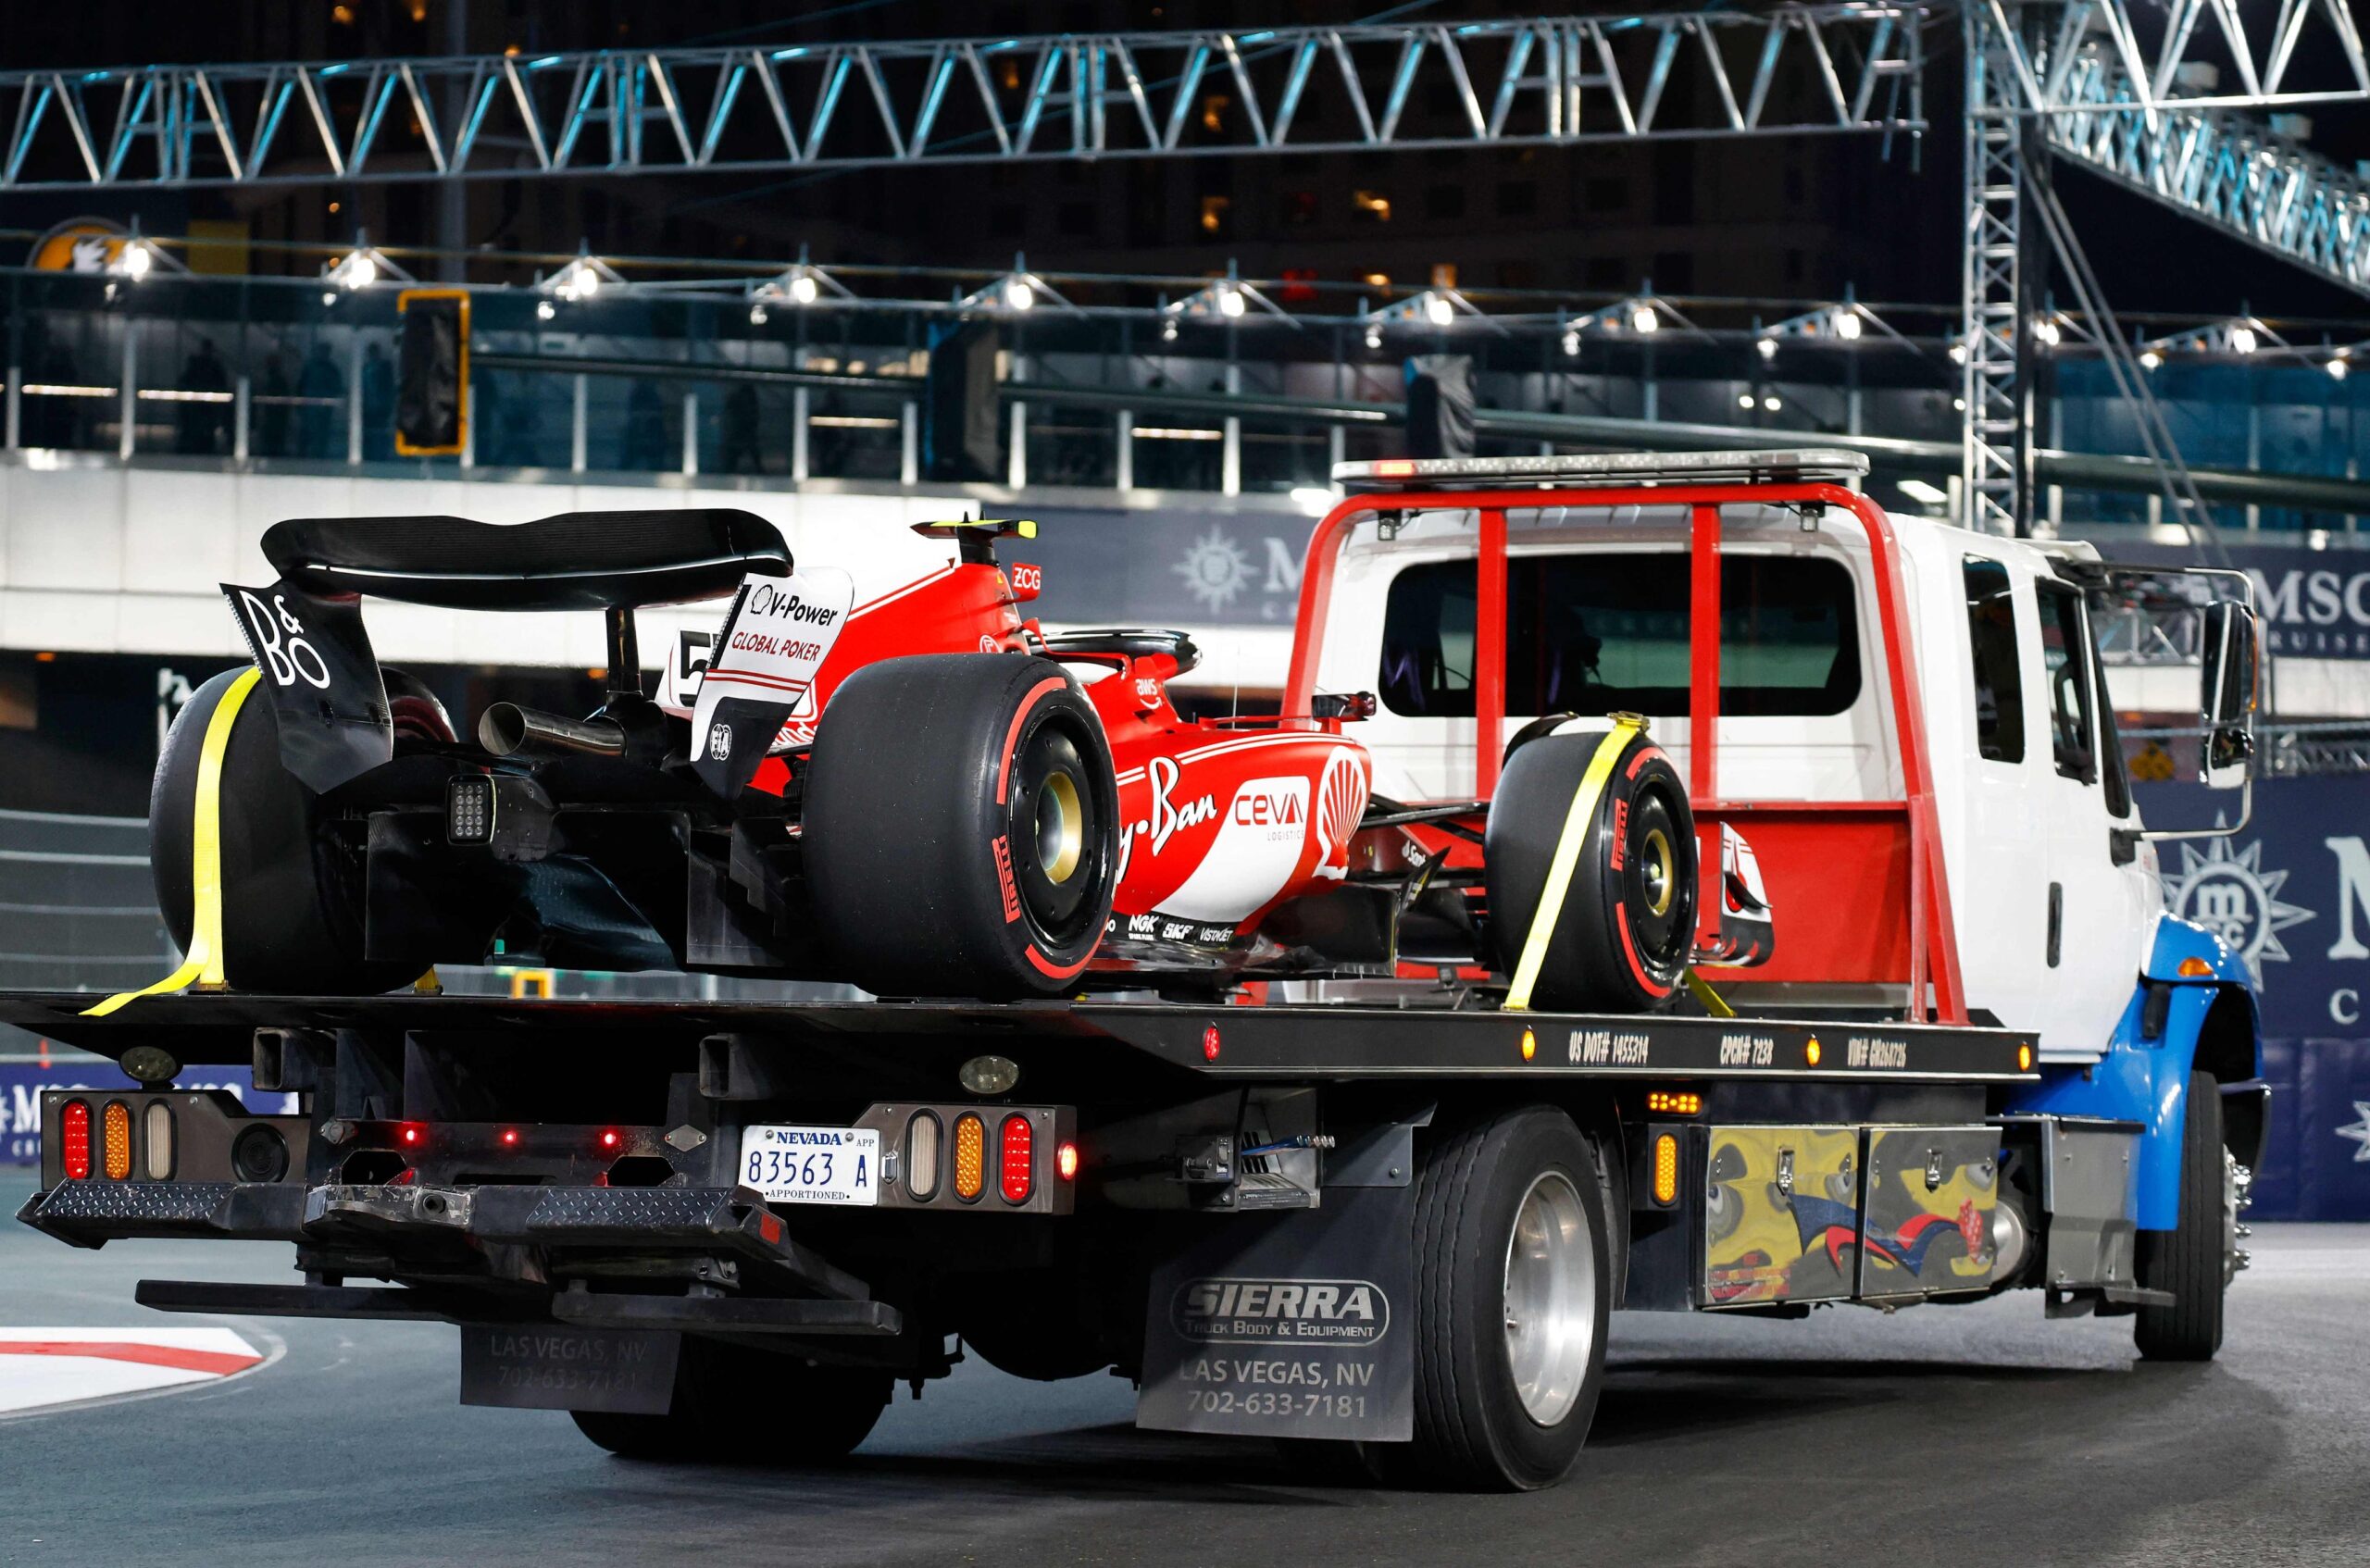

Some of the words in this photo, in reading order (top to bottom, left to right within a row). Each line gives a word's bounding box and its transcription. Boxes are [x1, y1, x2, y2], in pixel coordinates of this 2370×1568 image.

[769, 591, 839, 627] V-Power
[731, 631, 780, 655] GLOBAL
[779, 639, 822, 662] POKER
[1266, 828, 1305, 842] LOGISTICS
[992, 834, 1022, 924] PIRELLI
[1128, 914, 1160, 933] NGK
[1161, 922, 1194, 940] SKF
[1568, 1031, 1583, 1063] US
[1583, 1031, 1611, 1064] DOT#
[1612, 1035, 1650, 1064] 1455314
[1752, 1038, 1775, 1065] 7238
[777, 1131, 842, 1146] NEVADA
[856, 1139, 875, 1148] APP
[748, 1151, 834, 1186] 83563
[854, 1154, 867, 1188] A
[769, 1189, 846, 1201] APPORTIONED
[1184, 1283, 1375, 1320] SIERRA
[1277, 1322, 1291, 1337] &
[491, 1335, 530, 1358] LAS
[617, 1340, 649, 1363] NV
[1179, 1358, 1228, 1383] LAS
[1234, 1360, 1329, 1389] VEGAS,
[1336, 1363, 1376, 1388] NV
[1187, 1389, 1366, 1419] 702-633-7181
